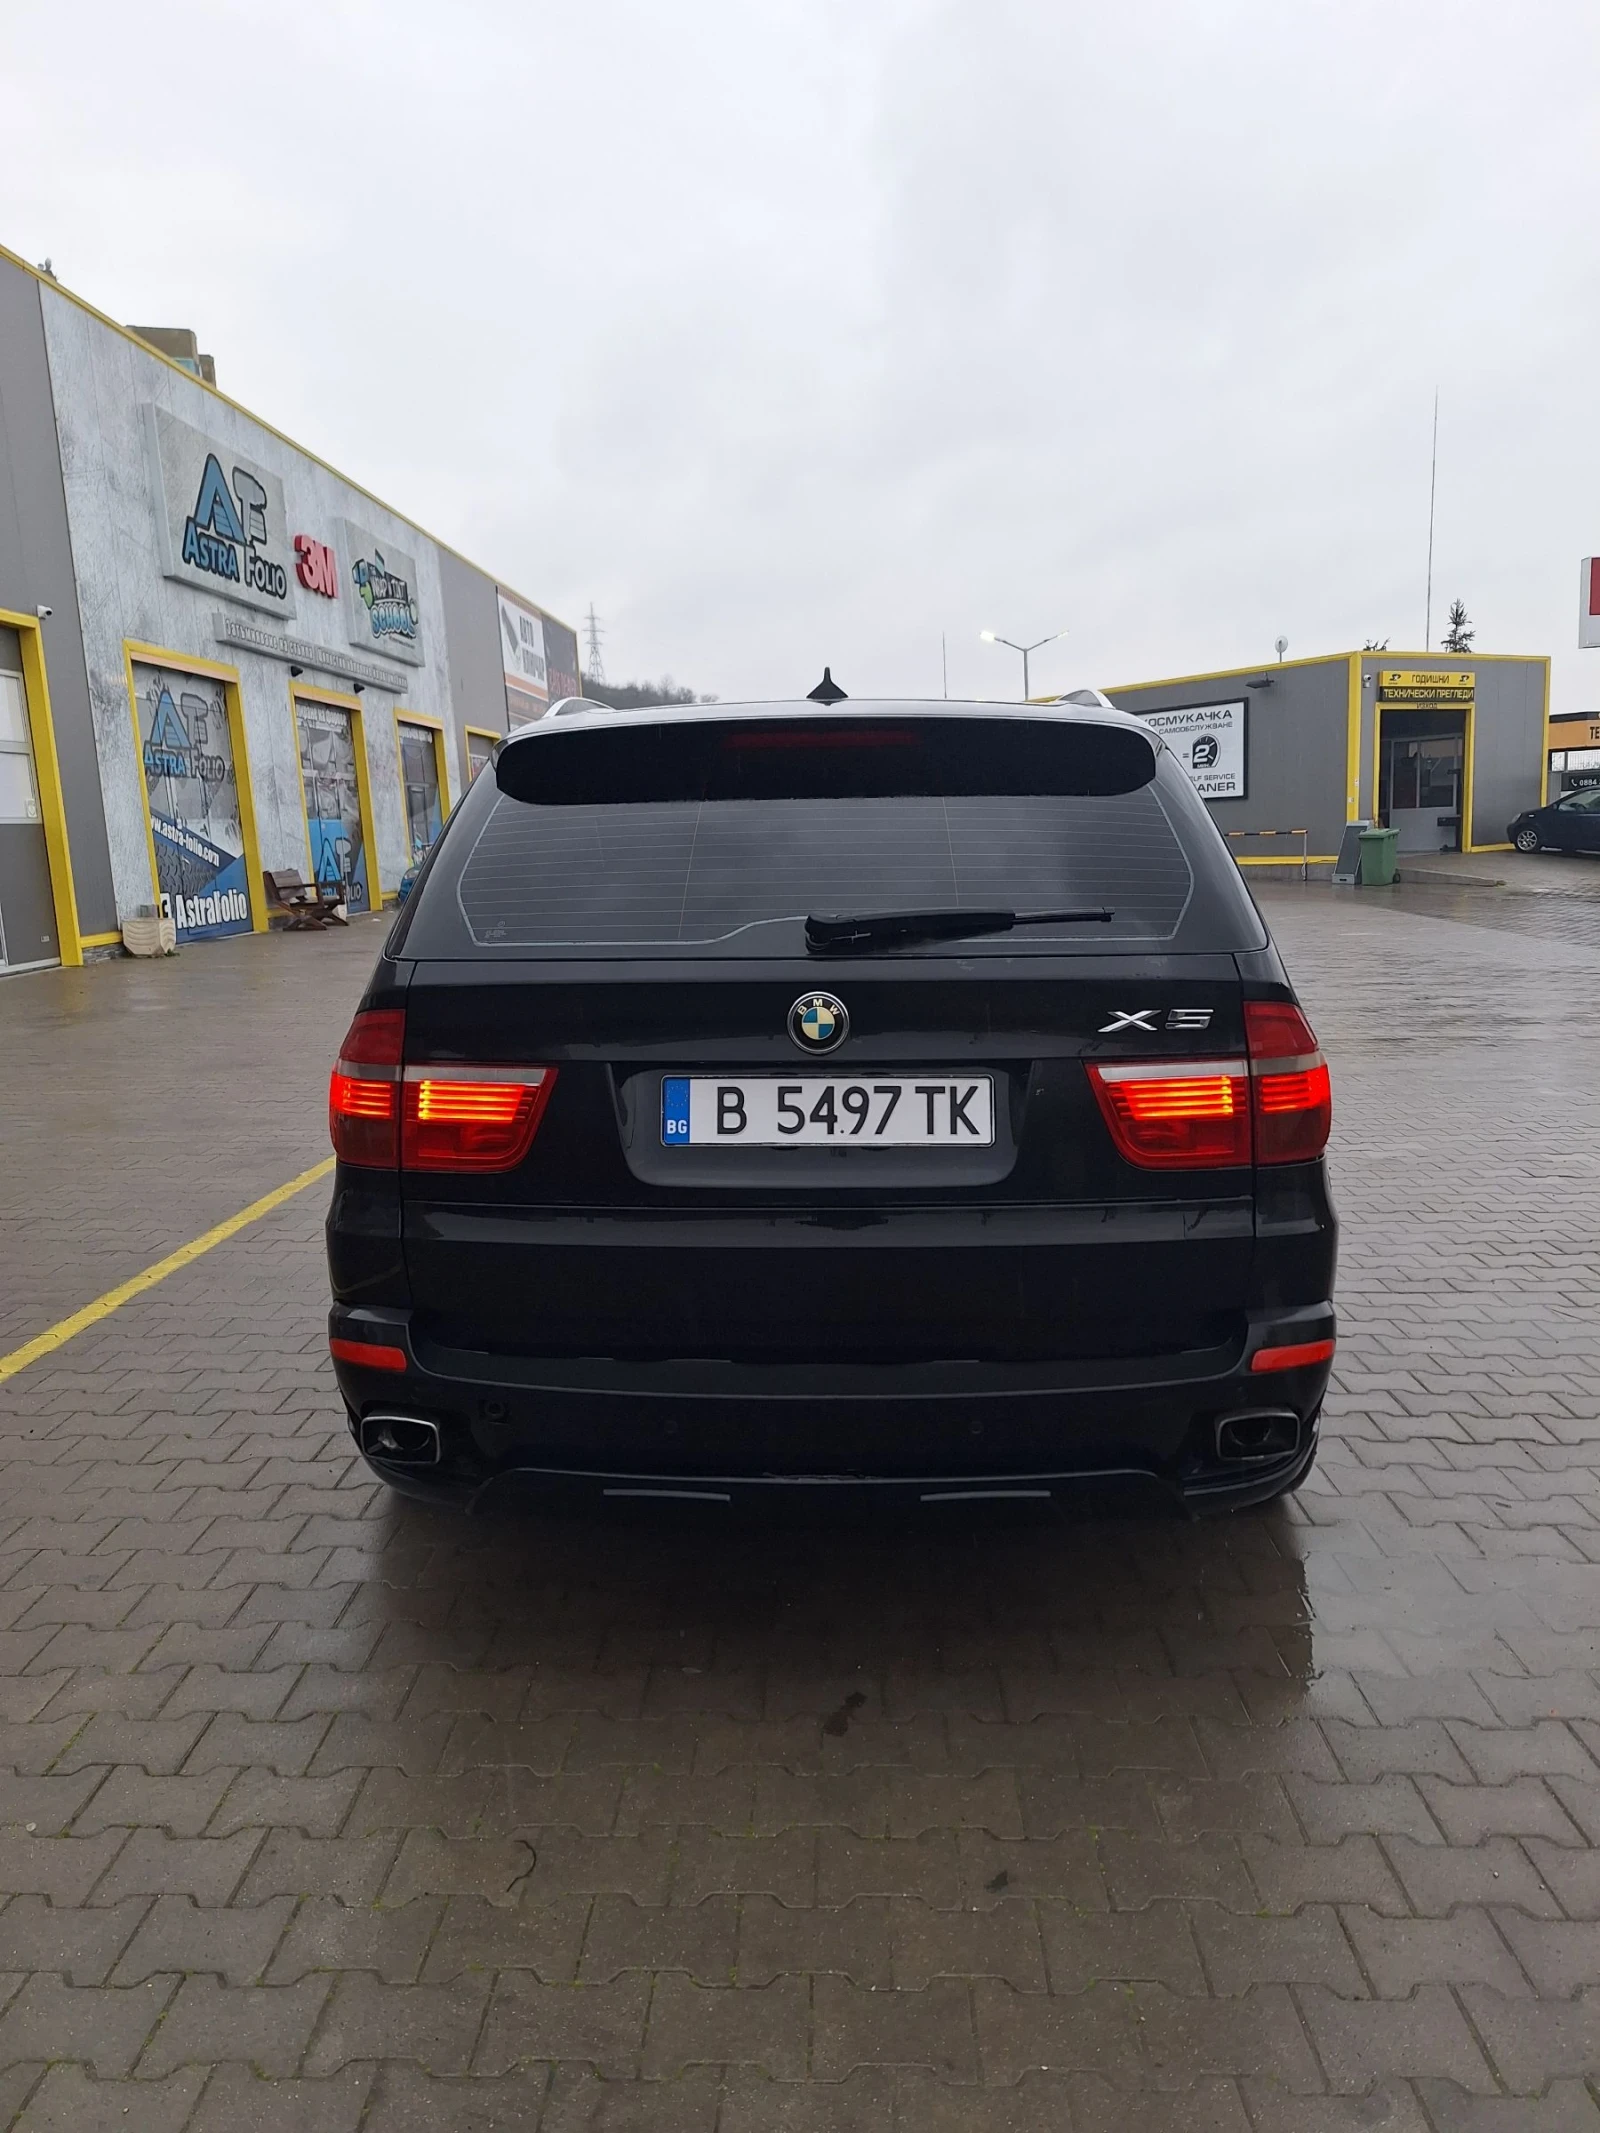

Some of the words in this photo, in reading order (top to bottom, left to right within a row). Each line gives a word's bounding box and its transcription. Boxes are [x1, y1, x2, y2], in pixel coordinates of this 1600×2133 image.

[182, 516, 240, 582] ASTRA
[244, 545, 287, 600] FOLIO
[295, 534, 338, 599] 3M
[370, 603, 416, 639] SCHOOL
[1412, 674, 1449, 685] ГОДИШНИ
[1384, 689, 1435, 698] ТЕХНИЧЕСКИ
[1436, 690, 1474, 699] ПРЕГЛЕДИ
[1145, 709, 1232, 727] ОСМУКАЧКА
[1159, 722, 1233, 735] САМООБСЛУЖВАНЕ
[189, 746, 225, 782] FOLIO
[1204, 773, 1236, 781] SERVICE
[1198, 782, 1236, 792] ANER
[175, 889, 248, 929] Astrafolio
[797, 998, 840, 1016] BMW
[1098, 1008, 1214, 1033] X5
[717, 1086, 747, 1134] B
[777, 1086, 901, 1134] 5497
[915, 1086, 980, 1135] TK
[667, 1119, 688, 1134] BG
